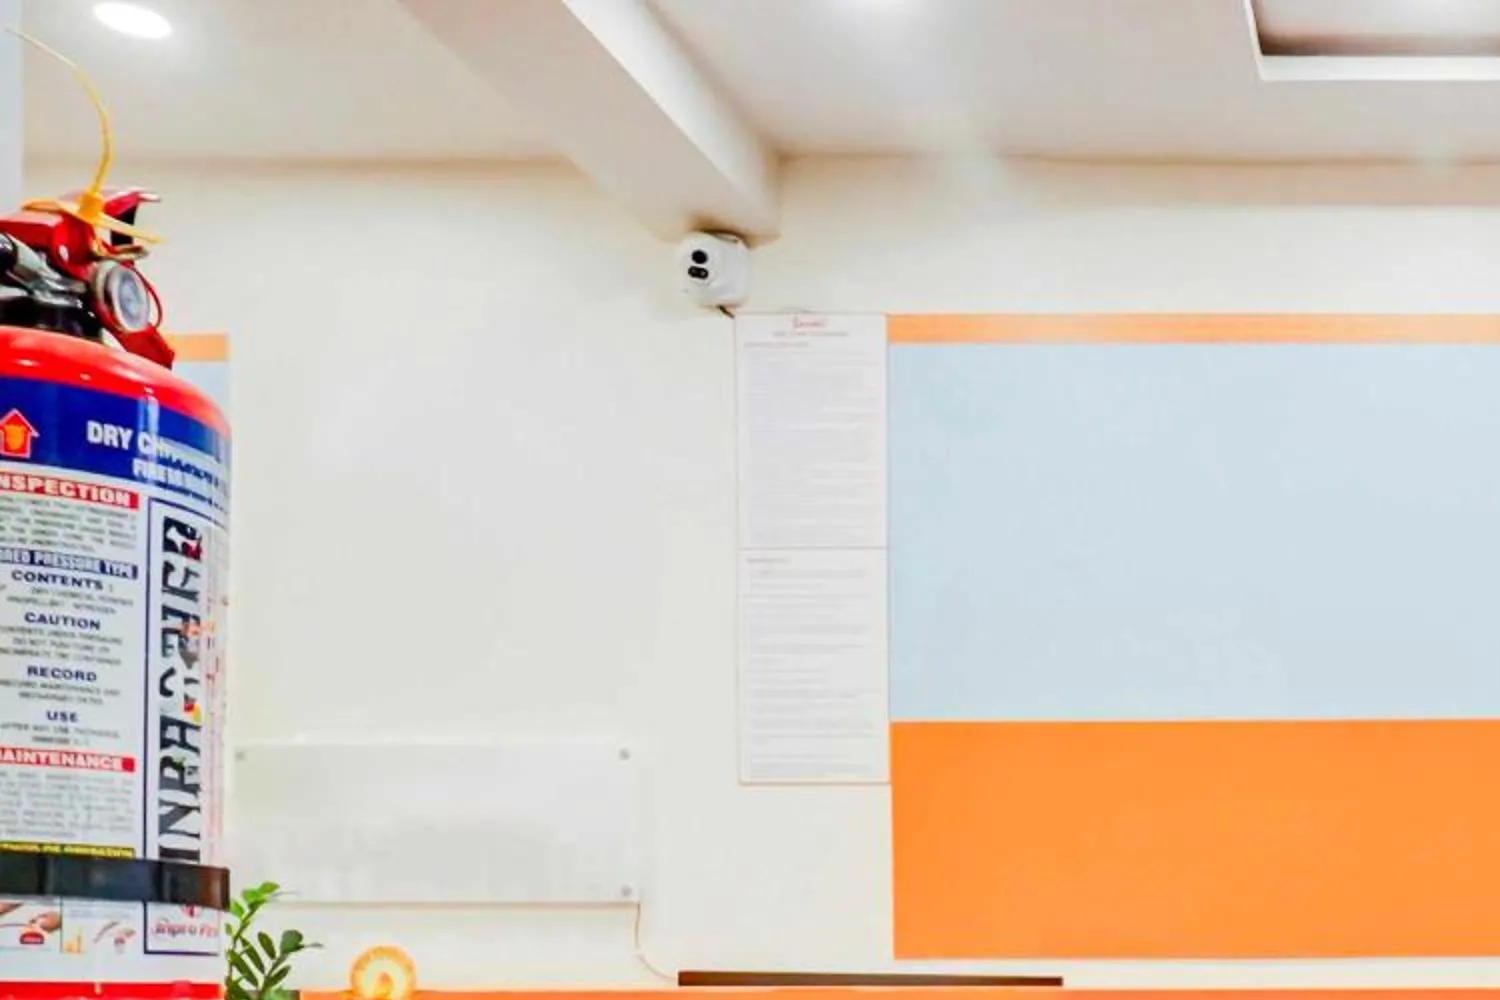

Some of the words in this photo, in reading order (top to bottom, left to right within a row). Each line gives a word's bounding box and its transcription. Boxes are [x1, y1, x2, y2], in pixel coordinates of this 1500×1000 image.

[86, 420, 133, 450] DRY
[10, 569, 104, 590] CONTENTS
[24, 611, 101, 631] CAUTION
[26, 665, 98, 682] RECORD
[46, 709, 79, 723] USE
[0, 748, 123, 770] AINTENANCE
